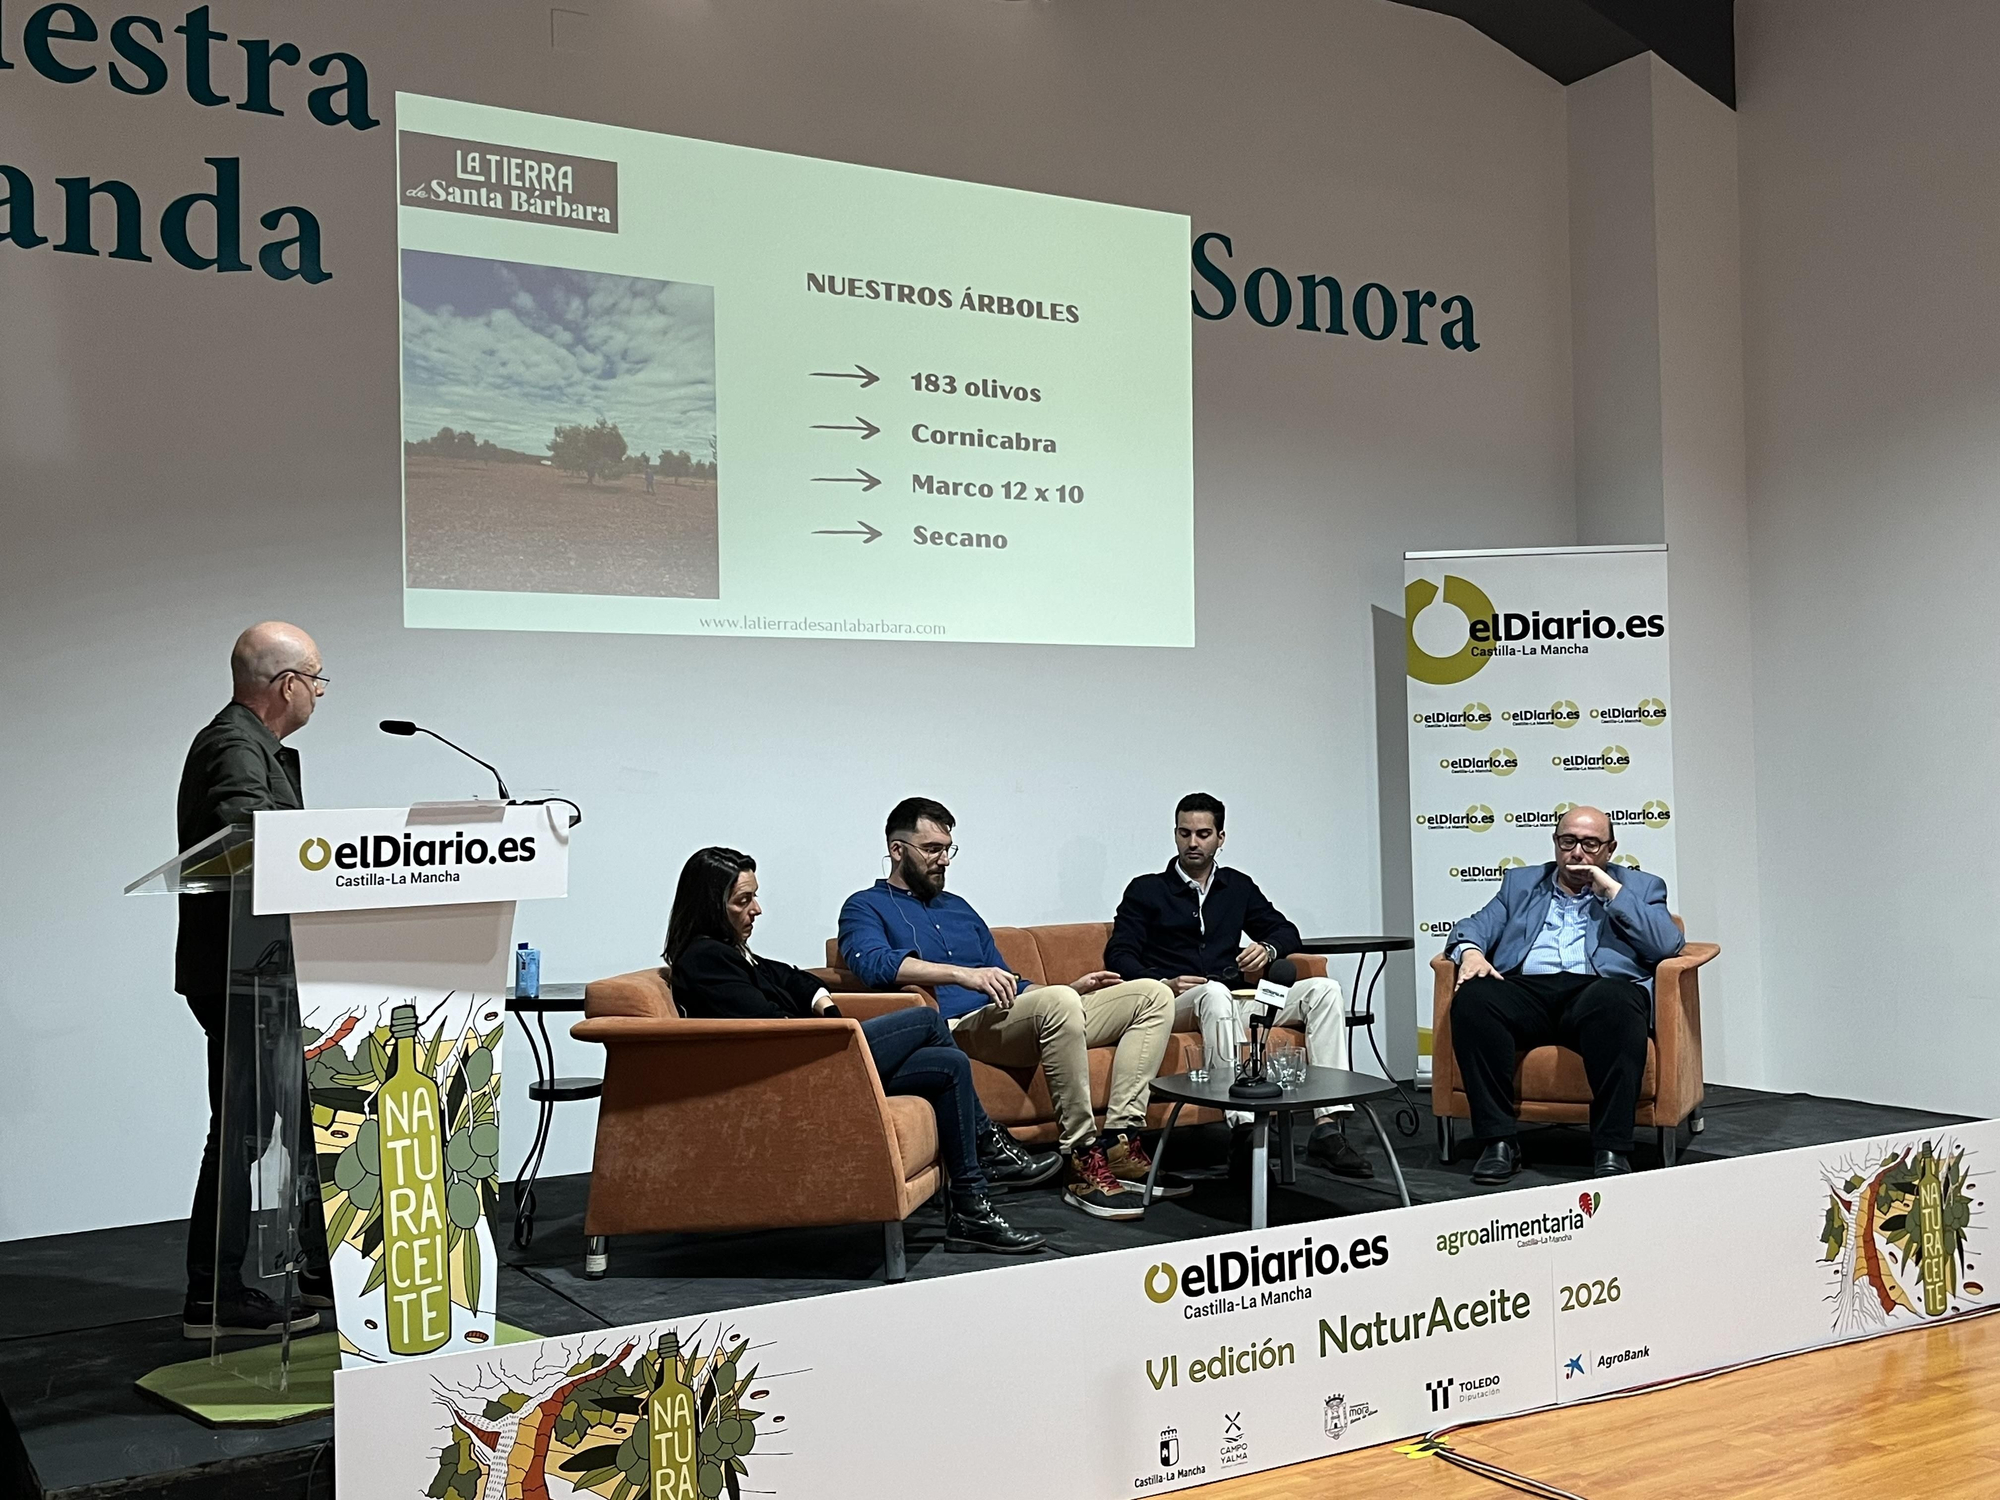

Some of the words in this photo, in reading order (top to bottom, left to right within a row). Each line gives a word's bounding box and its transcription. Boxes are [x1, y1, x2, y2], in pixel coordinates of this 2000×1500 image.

[0, 0, 381, 131] estra
[456, 149, 485, 182] LA
[486, 154, 573, 194] TIERRA
[405, 182, 428, 198] de
[430, 178, 503, 210] Santa
[510, 189, 611, 224] Bárbara
[806, 272, 953, 309] NUESTROS
[959, 286, 1080, 324] ÁRBOLES
[1190, 232, 1481, 353] Sonora
[911, 371, 958, 395] 183
[964, 378, 1042, 403] olivos
[911, 423, 1057, 454] Cornicabra
[912, 473, 994, 498] Marco
[1000, 480, 1028, 501] 12
[1034, 487, 1050, 502] x
[1055, 484, 1085, 504] 10
[912, 524, 1008, 550] Secano
[699, 615, 946, 635] www.latierradesantabarbara.com
[1468, 609, 1665, 643] elDiario.es
[1470, 645, 1538, 657] Castilla-La
[1540, 643, 1589, 656] Mancha
[1424, 711, 1492, 723] elDiario.es
[1512, 709, 1580, 721] elDiario.es
[1600, 707, 1667, 719] elDiario.es
[1450, 756, 1518, 768] elDiario.es
[1562, 754, 1630, 766] elDiario.es
[1427, 812, 1495, 824] elDiario.es
[1514, 811, 1564, 823] elDiari
[334, 831, 537, 870] elDiario.es
[335, 872, 407, 888] Castilla-La
[410, 870, 460, 885] Mancha
[1460, 865, 1509, 877] elDiari
[384, 1086, 435, 1137] NA
[386, 1134, 438, 1186] TU
[1921, 1182, 1939, 1205] NA
[389, 1184, 443, 1238] RA
[1922, 1206, 1941, 1232] TU
[1436, 1208, 1584, 1256] agroalimentaria
[1923, 1231, 1942, 1257] RA
[391, 1233, 443, 1289] CEI
[1181, 1234, 1389, 1298] elDiario.es
[1924, 1257, 1943, 1283] CEI
[1184, 1294, 1258, 1320] Castilla-La
[1261, 1285, 1313, 1307] Mancha
[1926, 1282, 1945, 1312] TE
[393, 1285, 445, 1345] TE
[1146, 1354, 1178, 1391] VI
[1188, 1337, 1296, 1383] edición
[1318, 1288, 1531, 1358] NaturAceite
[1559, 1276, 1622, 1312] 2026
[1596, 1345, 1650, 1369] AgroBank
[1458, 1375, 1501, 1393] TOLEDO
[1459, 1387, 1501, 1403] Diputación
[653, 1393, 691, 1431] NA
[654, 1428, 693, 1467] TU
[1220, 1442, 1248, 1455] CAMPO
[1220, 1452, 1248, 1464] YALMA
[655, 1464, 695, 1500] RA
[1177, 1465, 1206, 1479] Mancha
